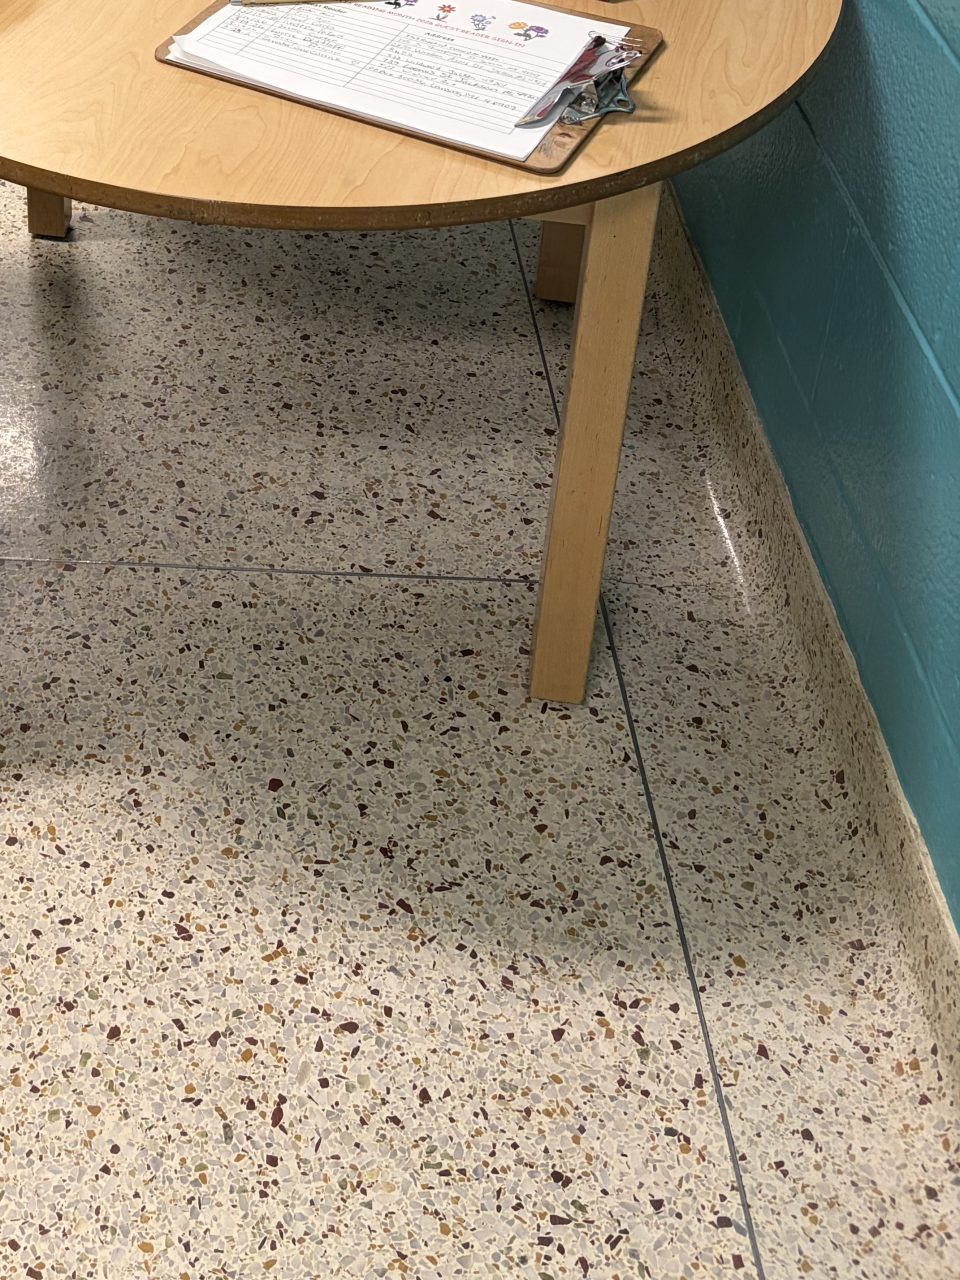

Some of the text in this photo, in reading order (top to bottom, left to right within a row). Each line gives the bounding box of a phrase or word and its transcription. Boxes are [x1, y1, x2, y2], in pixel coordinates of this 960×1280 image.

[353, 3, 385, 13] READING
[434, 23, 460, 32] GUEST
[461, 29, 490, 39] READER
[492, 36, 526, 48] SIGN-IN
[424, 31, 455, 42] Address
